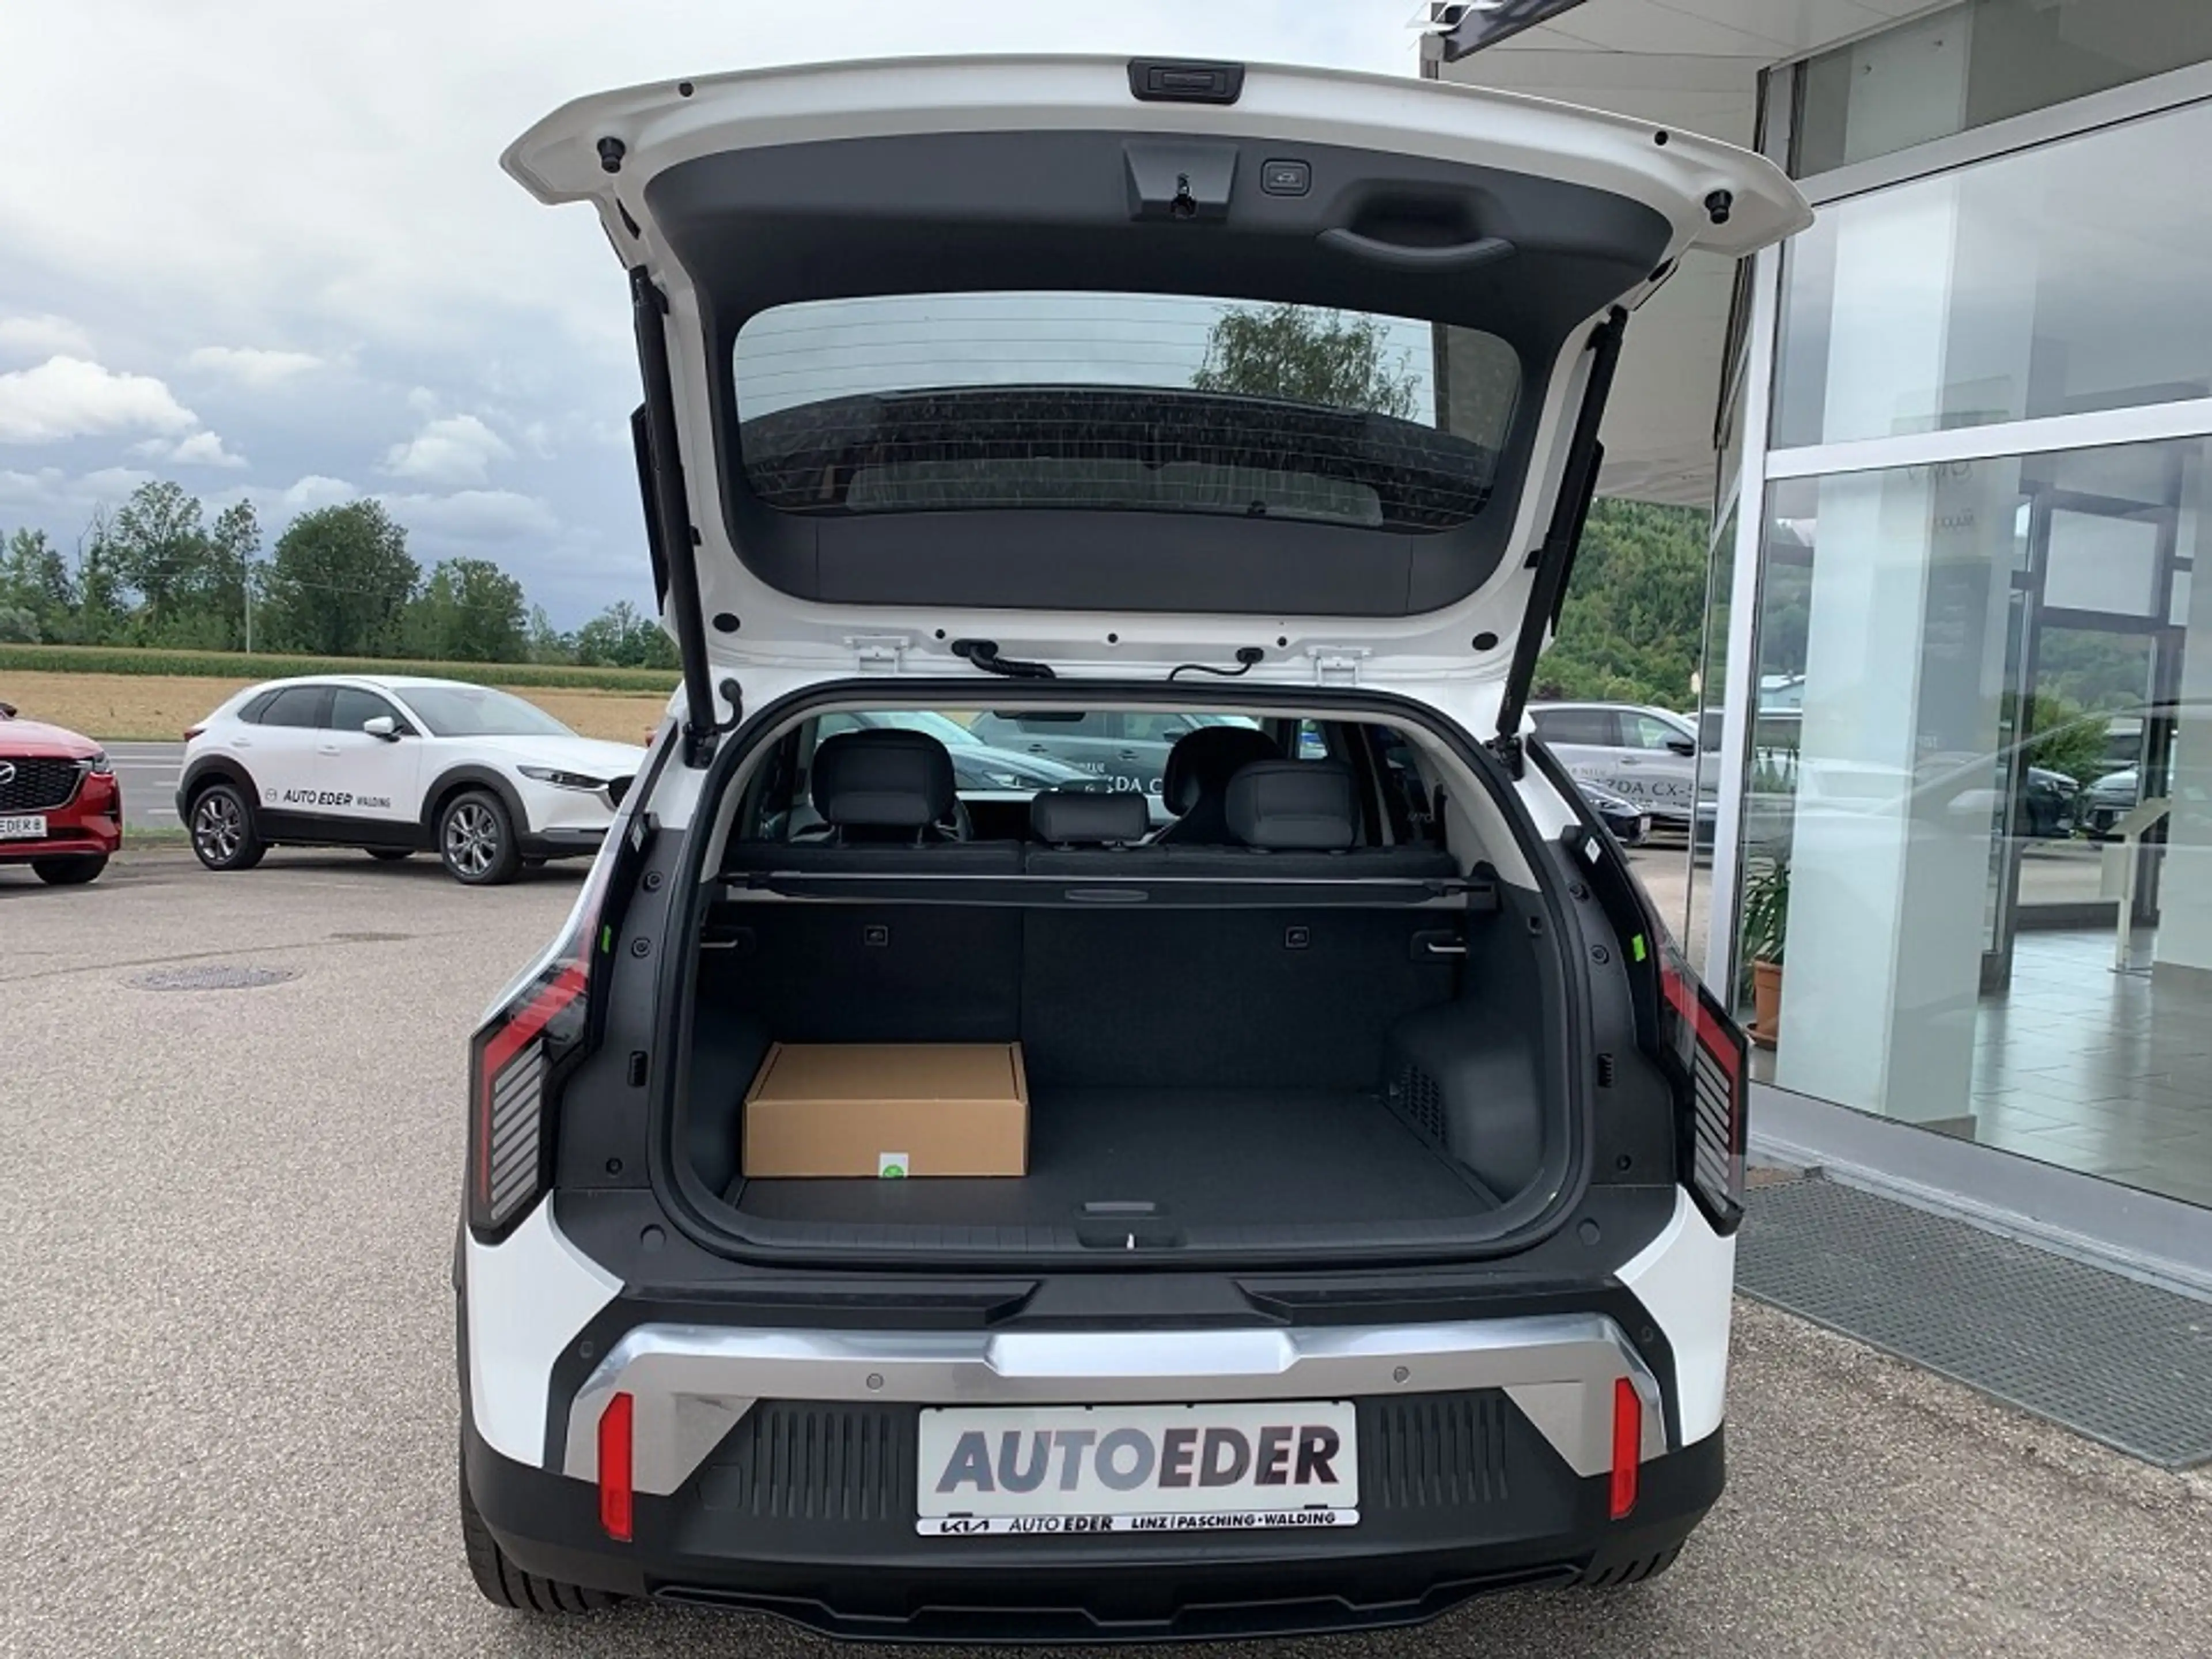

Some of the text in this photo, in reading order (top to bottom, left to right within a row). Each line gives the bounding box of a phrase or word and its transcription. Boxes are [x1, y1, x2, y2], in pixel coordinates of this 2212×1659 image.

[283, 789, 316, 804] AUTO
[318, 791, 353, 806] EDER
[940, 1520, 990, 1533] KIA
[1009, 1517, 1060, 1531] AUTO
[1063, 1516, 1114, 1531] EDER
